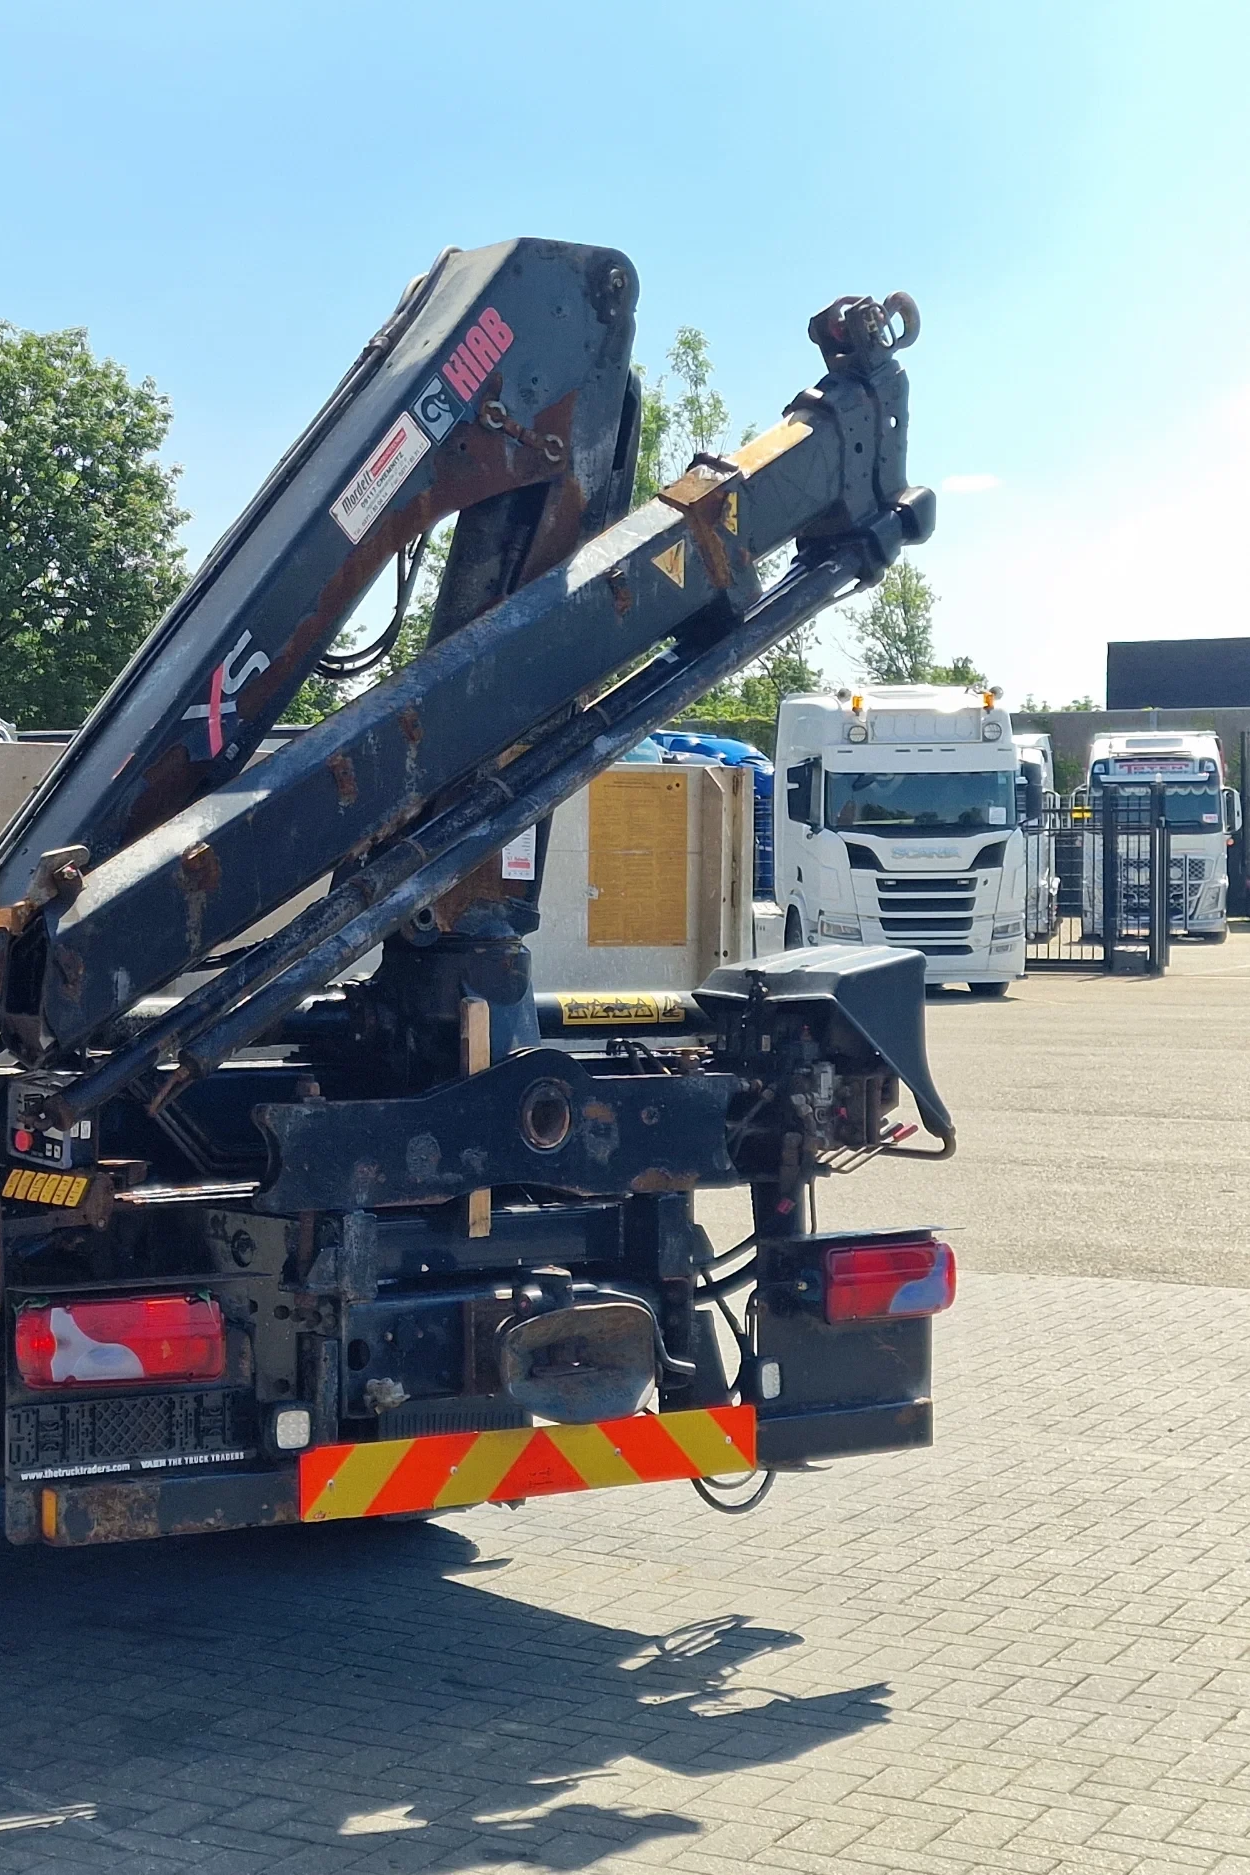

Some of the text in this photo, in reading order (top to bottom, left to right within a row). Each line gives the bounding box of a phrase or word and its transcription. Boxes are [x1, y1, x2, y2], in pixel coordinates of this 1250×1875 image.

[442, 306, 515, 402] HIAB
[340, 469, 375, 515] Mordell
[375, 450, 405, 488] CHEMNITZ
[181, 629, 271, 758] XS
[20, 1462, 131, 1481] www.thetrucktraders.com
[167, 1457, 183, 1467] THE
[184, 1454, 209, 1465] TRUCK
[210, 1451, 245, 1463] TRADERS
